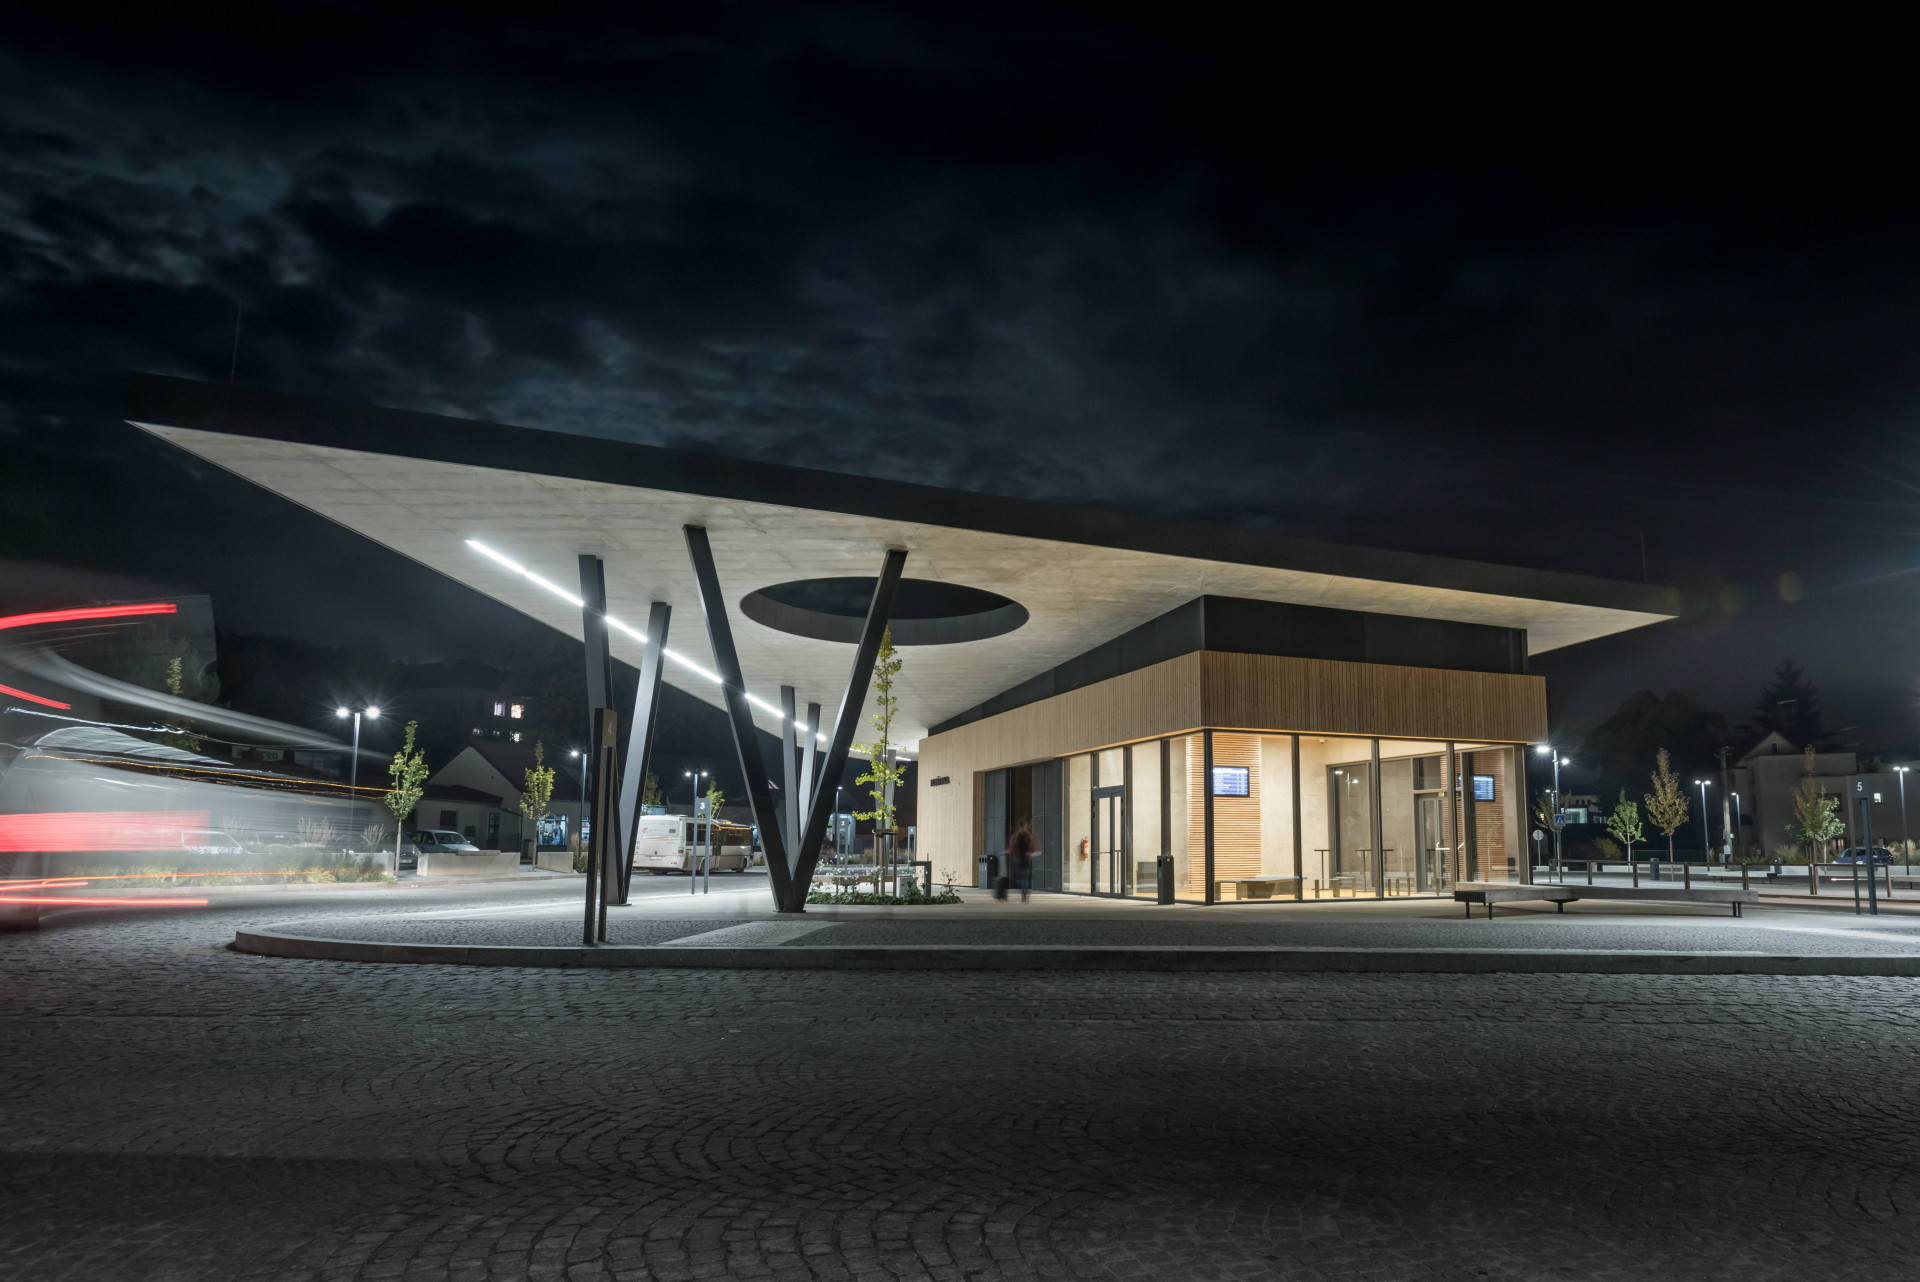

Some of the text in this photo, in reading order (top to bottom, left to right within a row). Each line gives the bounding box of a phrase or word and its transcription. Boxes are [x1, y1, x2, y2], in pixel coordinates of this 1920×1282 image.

[607, 720, 613, 737] 4
[1857, 781, 1863, 792] 5
[699, 801, 706, 810] 3
